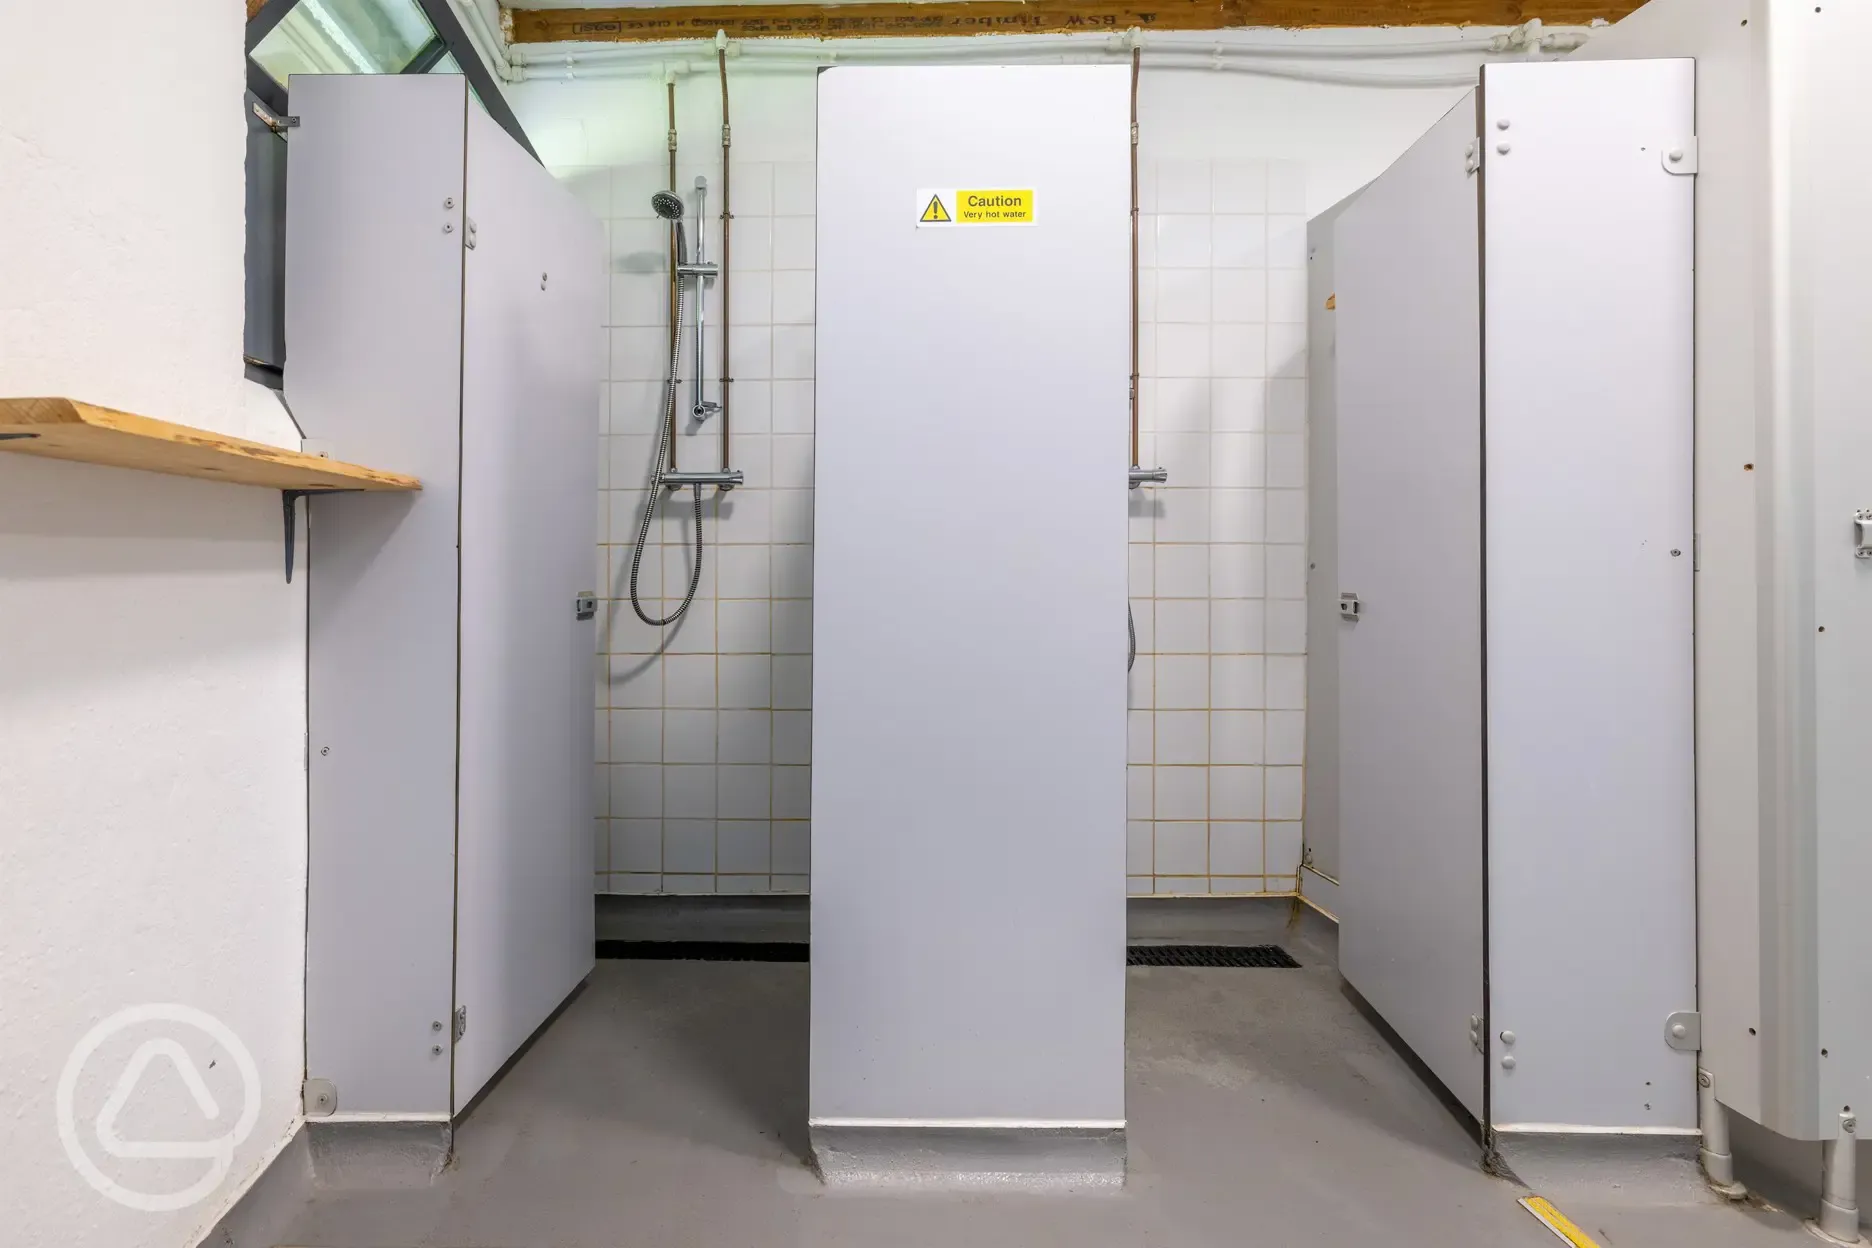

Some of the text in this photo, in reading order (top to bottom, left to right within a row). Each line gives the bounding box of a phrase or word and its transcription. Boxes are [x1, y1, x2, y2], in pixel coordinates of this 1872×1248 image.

[951, 15, 1047, 27] Timber
[1066, 14, 1117, 26] BSW
[968, 195, 1021, 207] Caution
[963, 211, 982, 219] Very
